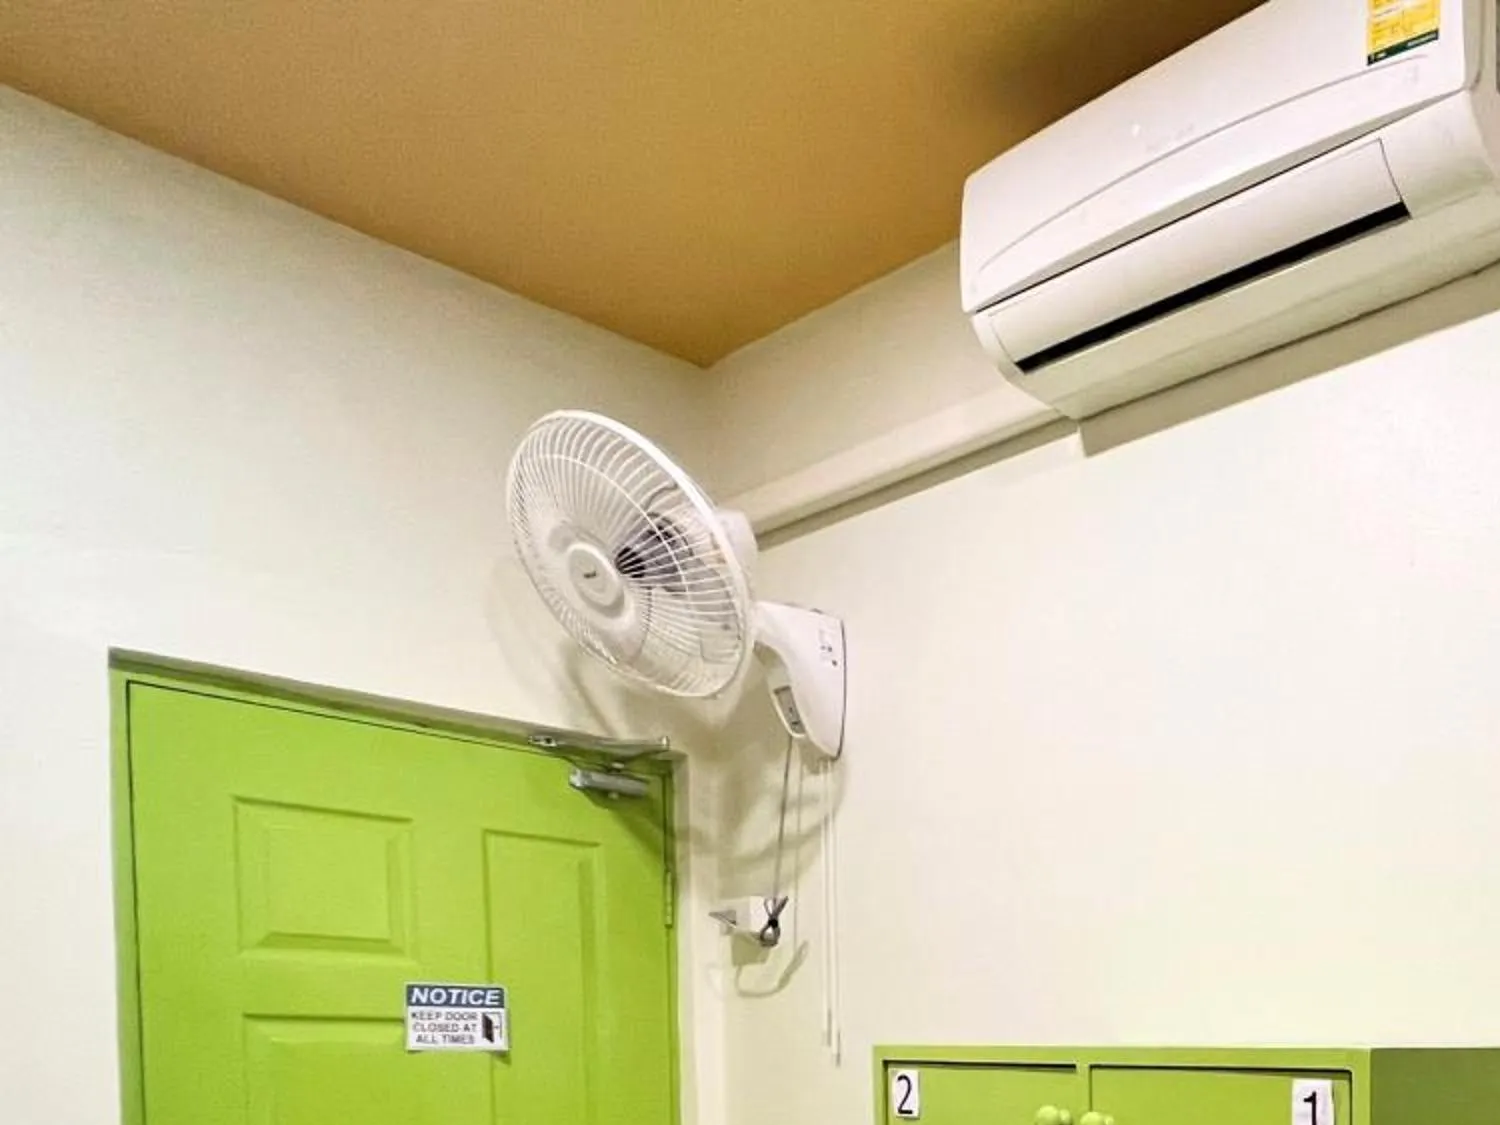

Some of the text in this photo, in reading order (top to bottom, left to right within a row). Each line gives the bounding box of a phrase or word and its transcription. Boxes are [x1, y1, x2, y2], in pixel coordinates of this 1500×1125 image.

[410, 987, 501, 1006] NOTICE
[445, 1011, 478, 1021] DOOR
[413, 1022, 477, 1033] CLOSED AT
[416, 1033, 438, 1043] ALL
[897, 1074, 913, 1115] 2
